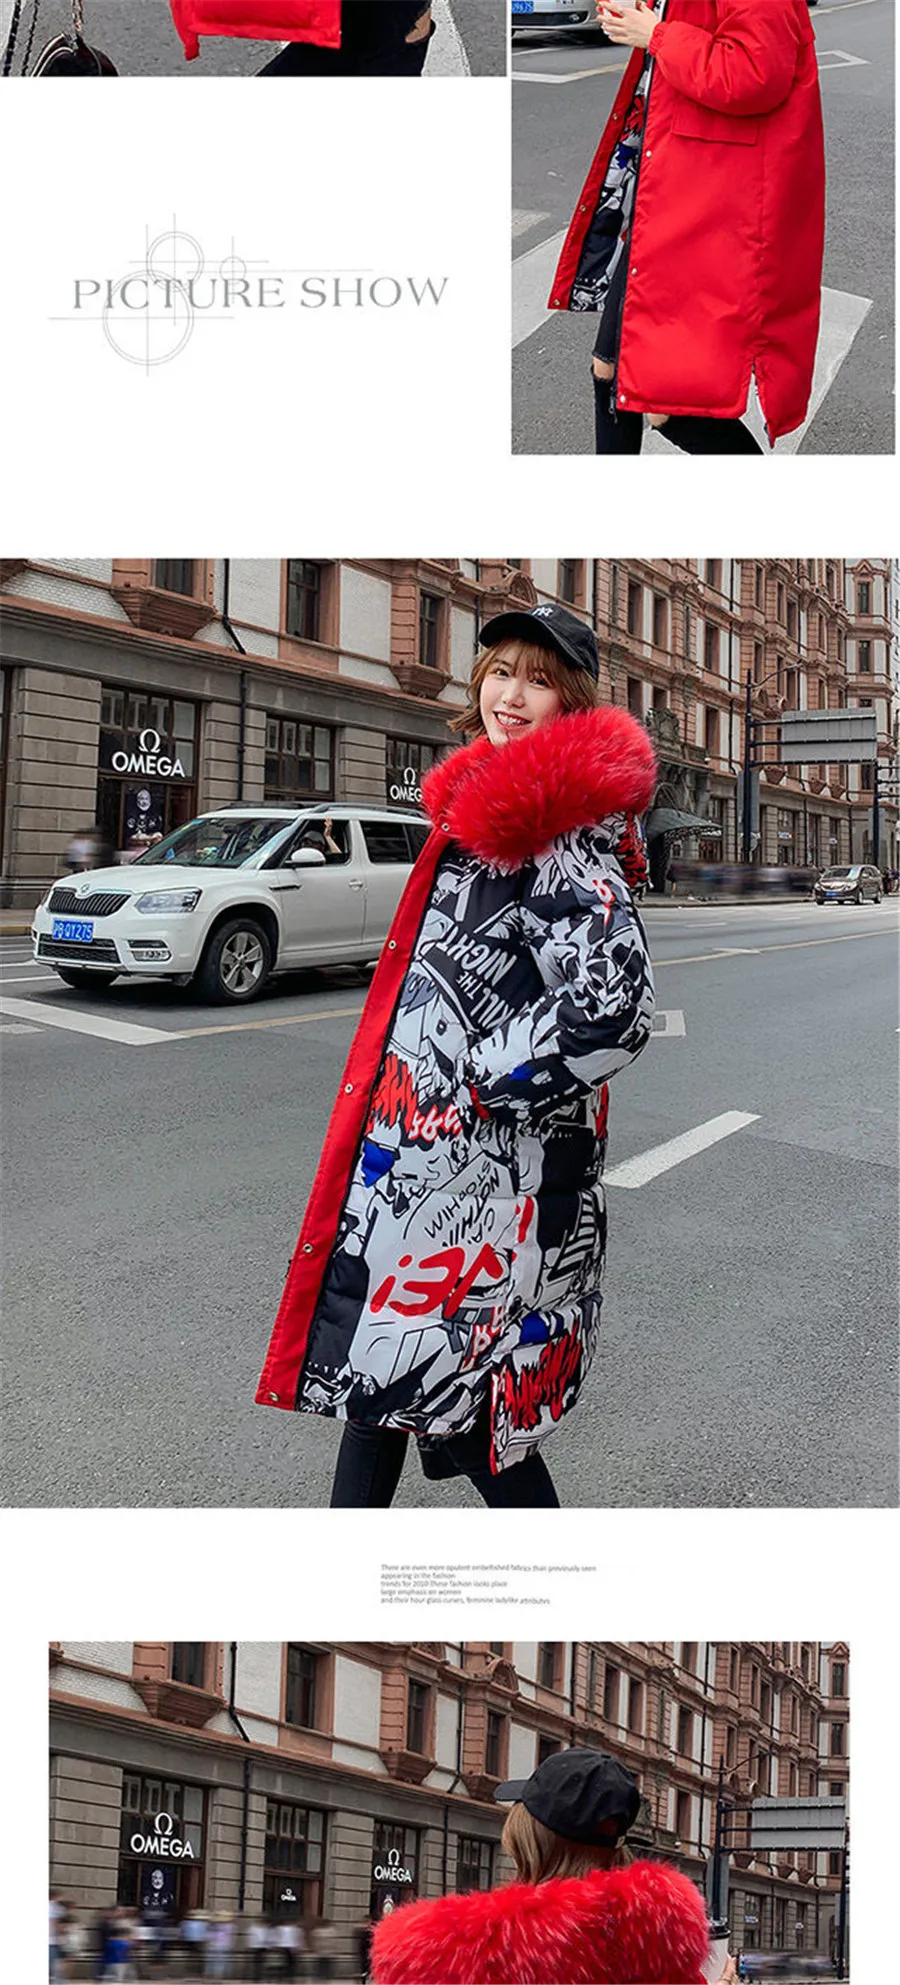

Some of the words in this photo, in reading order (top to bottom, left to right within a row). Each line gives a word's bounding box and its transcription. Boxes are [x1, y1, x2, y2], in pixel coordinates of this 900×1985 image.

[111, 752, 186, 778] OMEGA
[389, 784, 424, 803] OMEG
[435, 925, 518, 987] NIGHT
[456, 971, 483, 1000] THE
[130, 1832, 195, 1859] OMEGA
[374, 1864, 413, 1884] OMEGA
